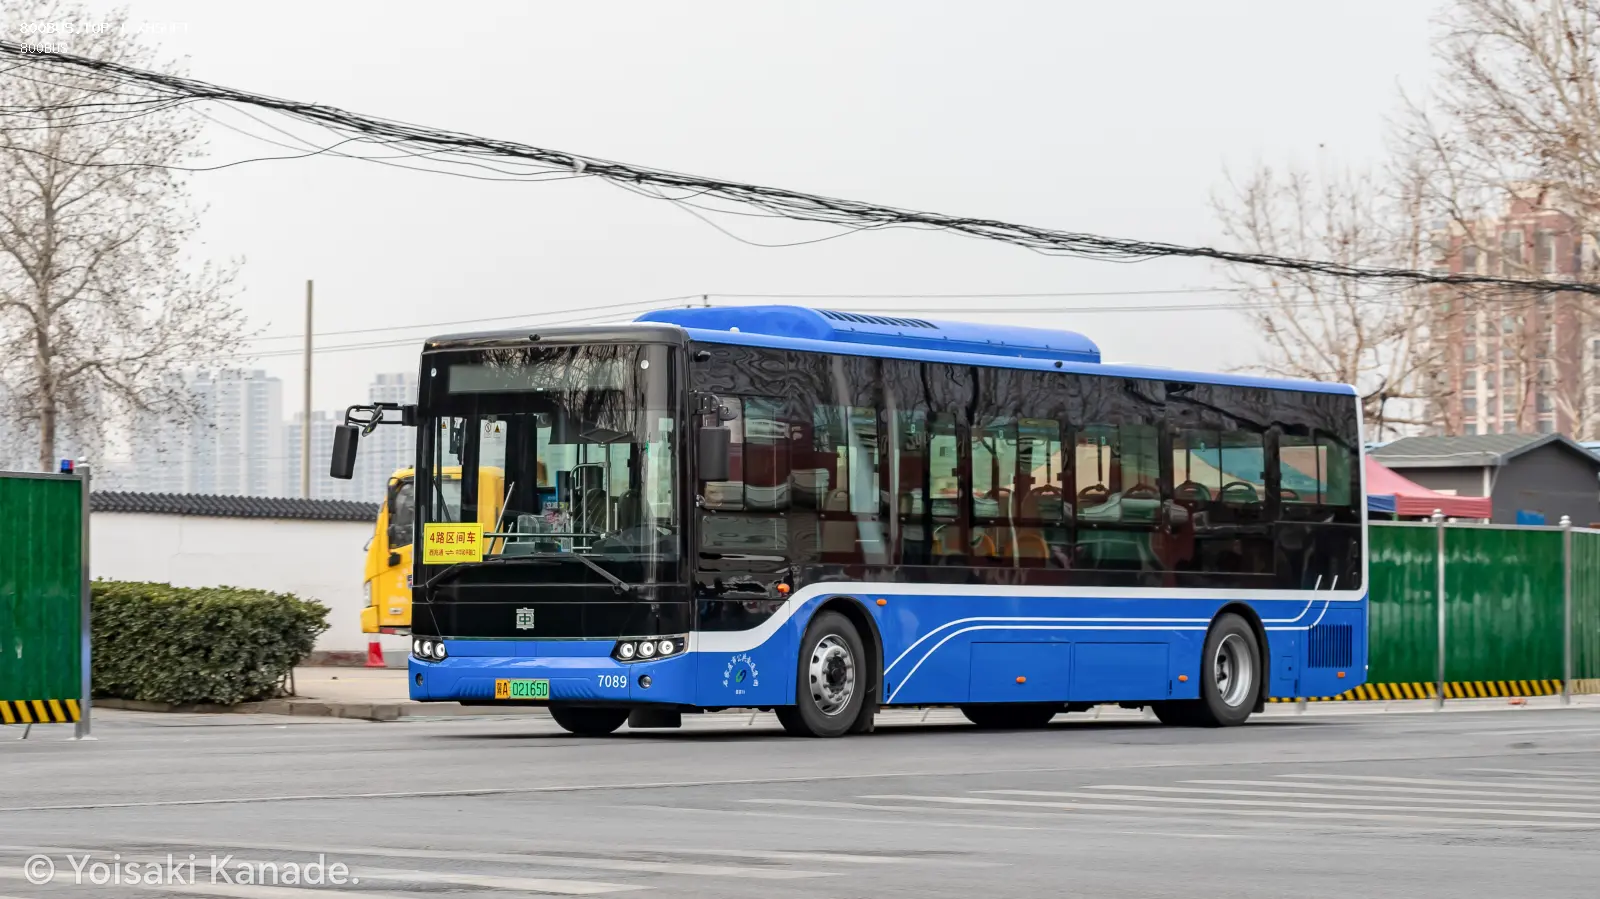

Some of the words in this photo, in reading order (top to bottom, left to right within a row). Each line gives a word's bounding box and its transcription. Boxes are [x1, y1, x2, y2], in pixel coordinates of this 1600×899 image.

[429, 531, 476, 544] 4路区间车
[597, 675, 627, 688] 7089
